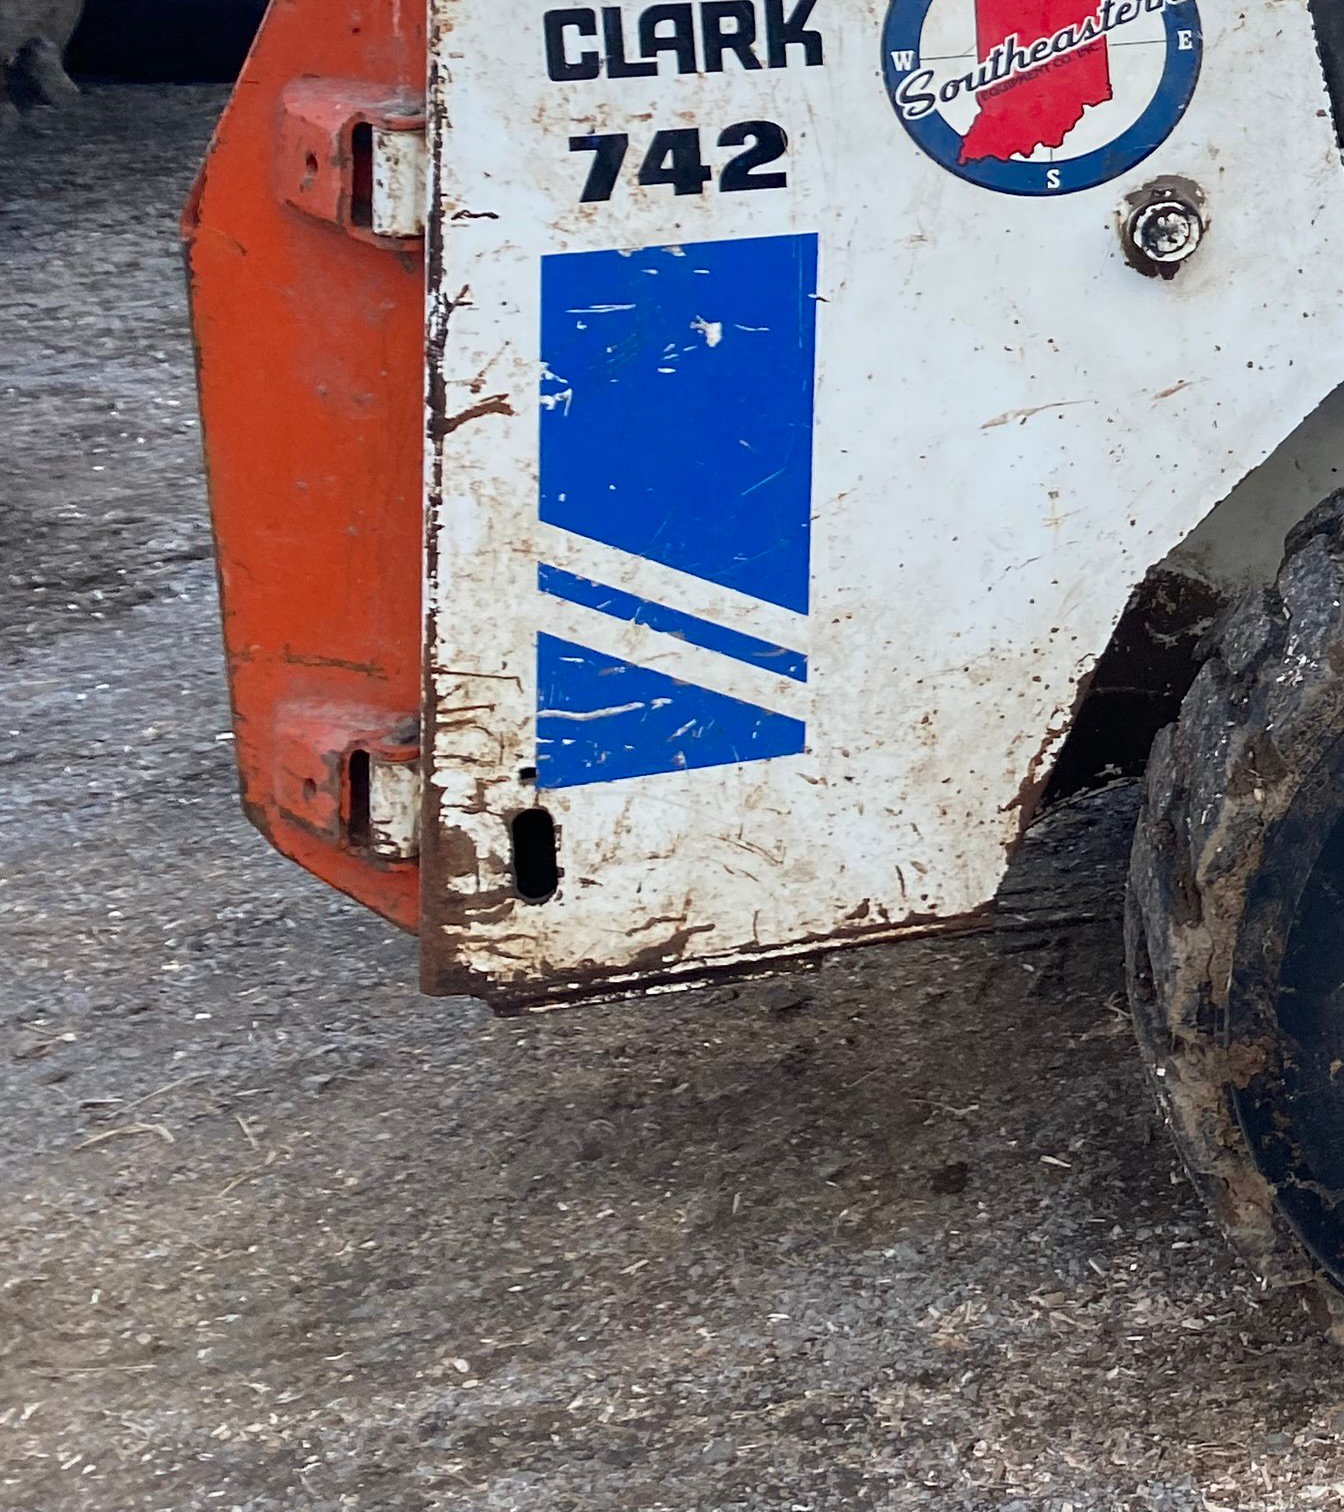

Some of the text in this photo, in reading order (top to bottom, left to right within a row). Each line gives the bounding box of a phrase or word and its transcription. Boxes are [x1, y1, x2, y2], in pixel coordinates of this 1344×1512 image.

[1177, 29, 1193, 50] E
[891, 50, 916, 71] W
[568, 120, 788, 203] 742
[1047, 169, 1060, 188] S
